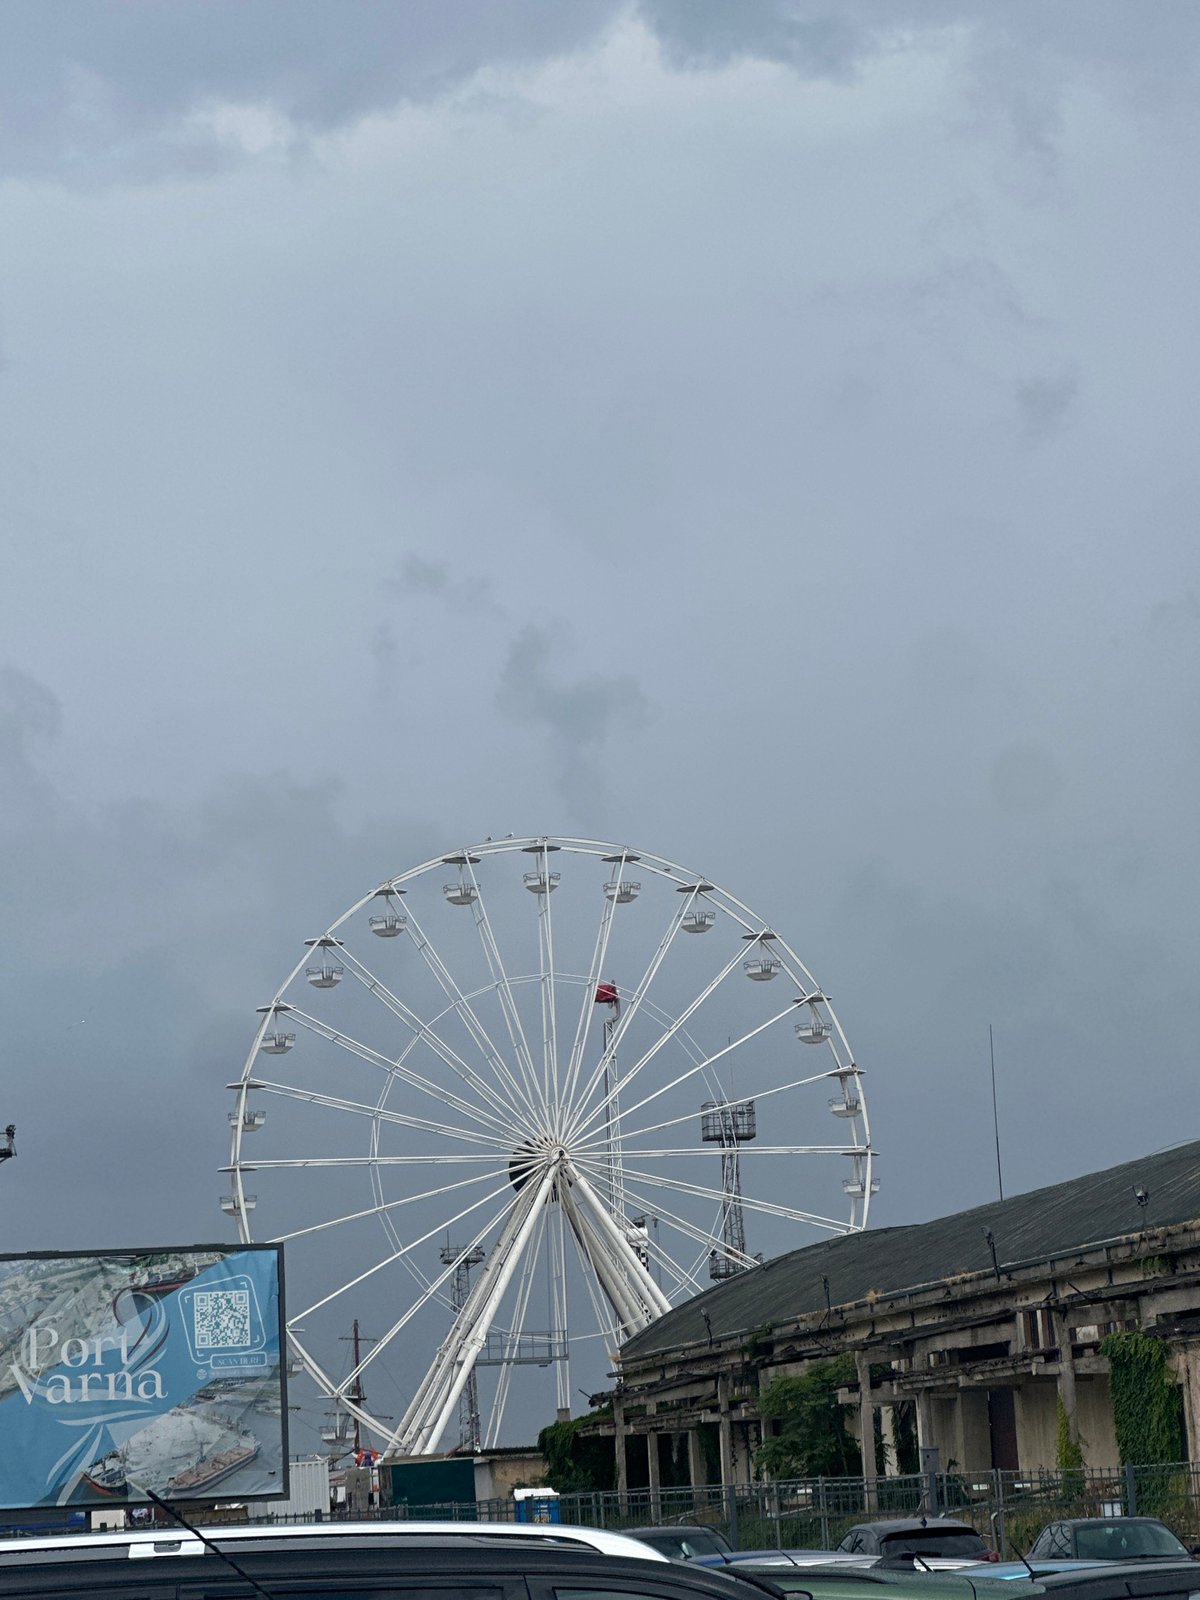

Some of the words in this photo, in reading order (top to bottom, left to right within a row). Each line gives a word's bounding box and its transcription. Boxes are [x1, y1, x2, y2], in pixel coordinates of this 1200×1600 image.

[26, 1327, 132, 1369] Port
[217, 1358, 239, 1366] SCAN
[240, 1356, 260, 1365] HERE
[7, 1363, 169, 1405] Varna
